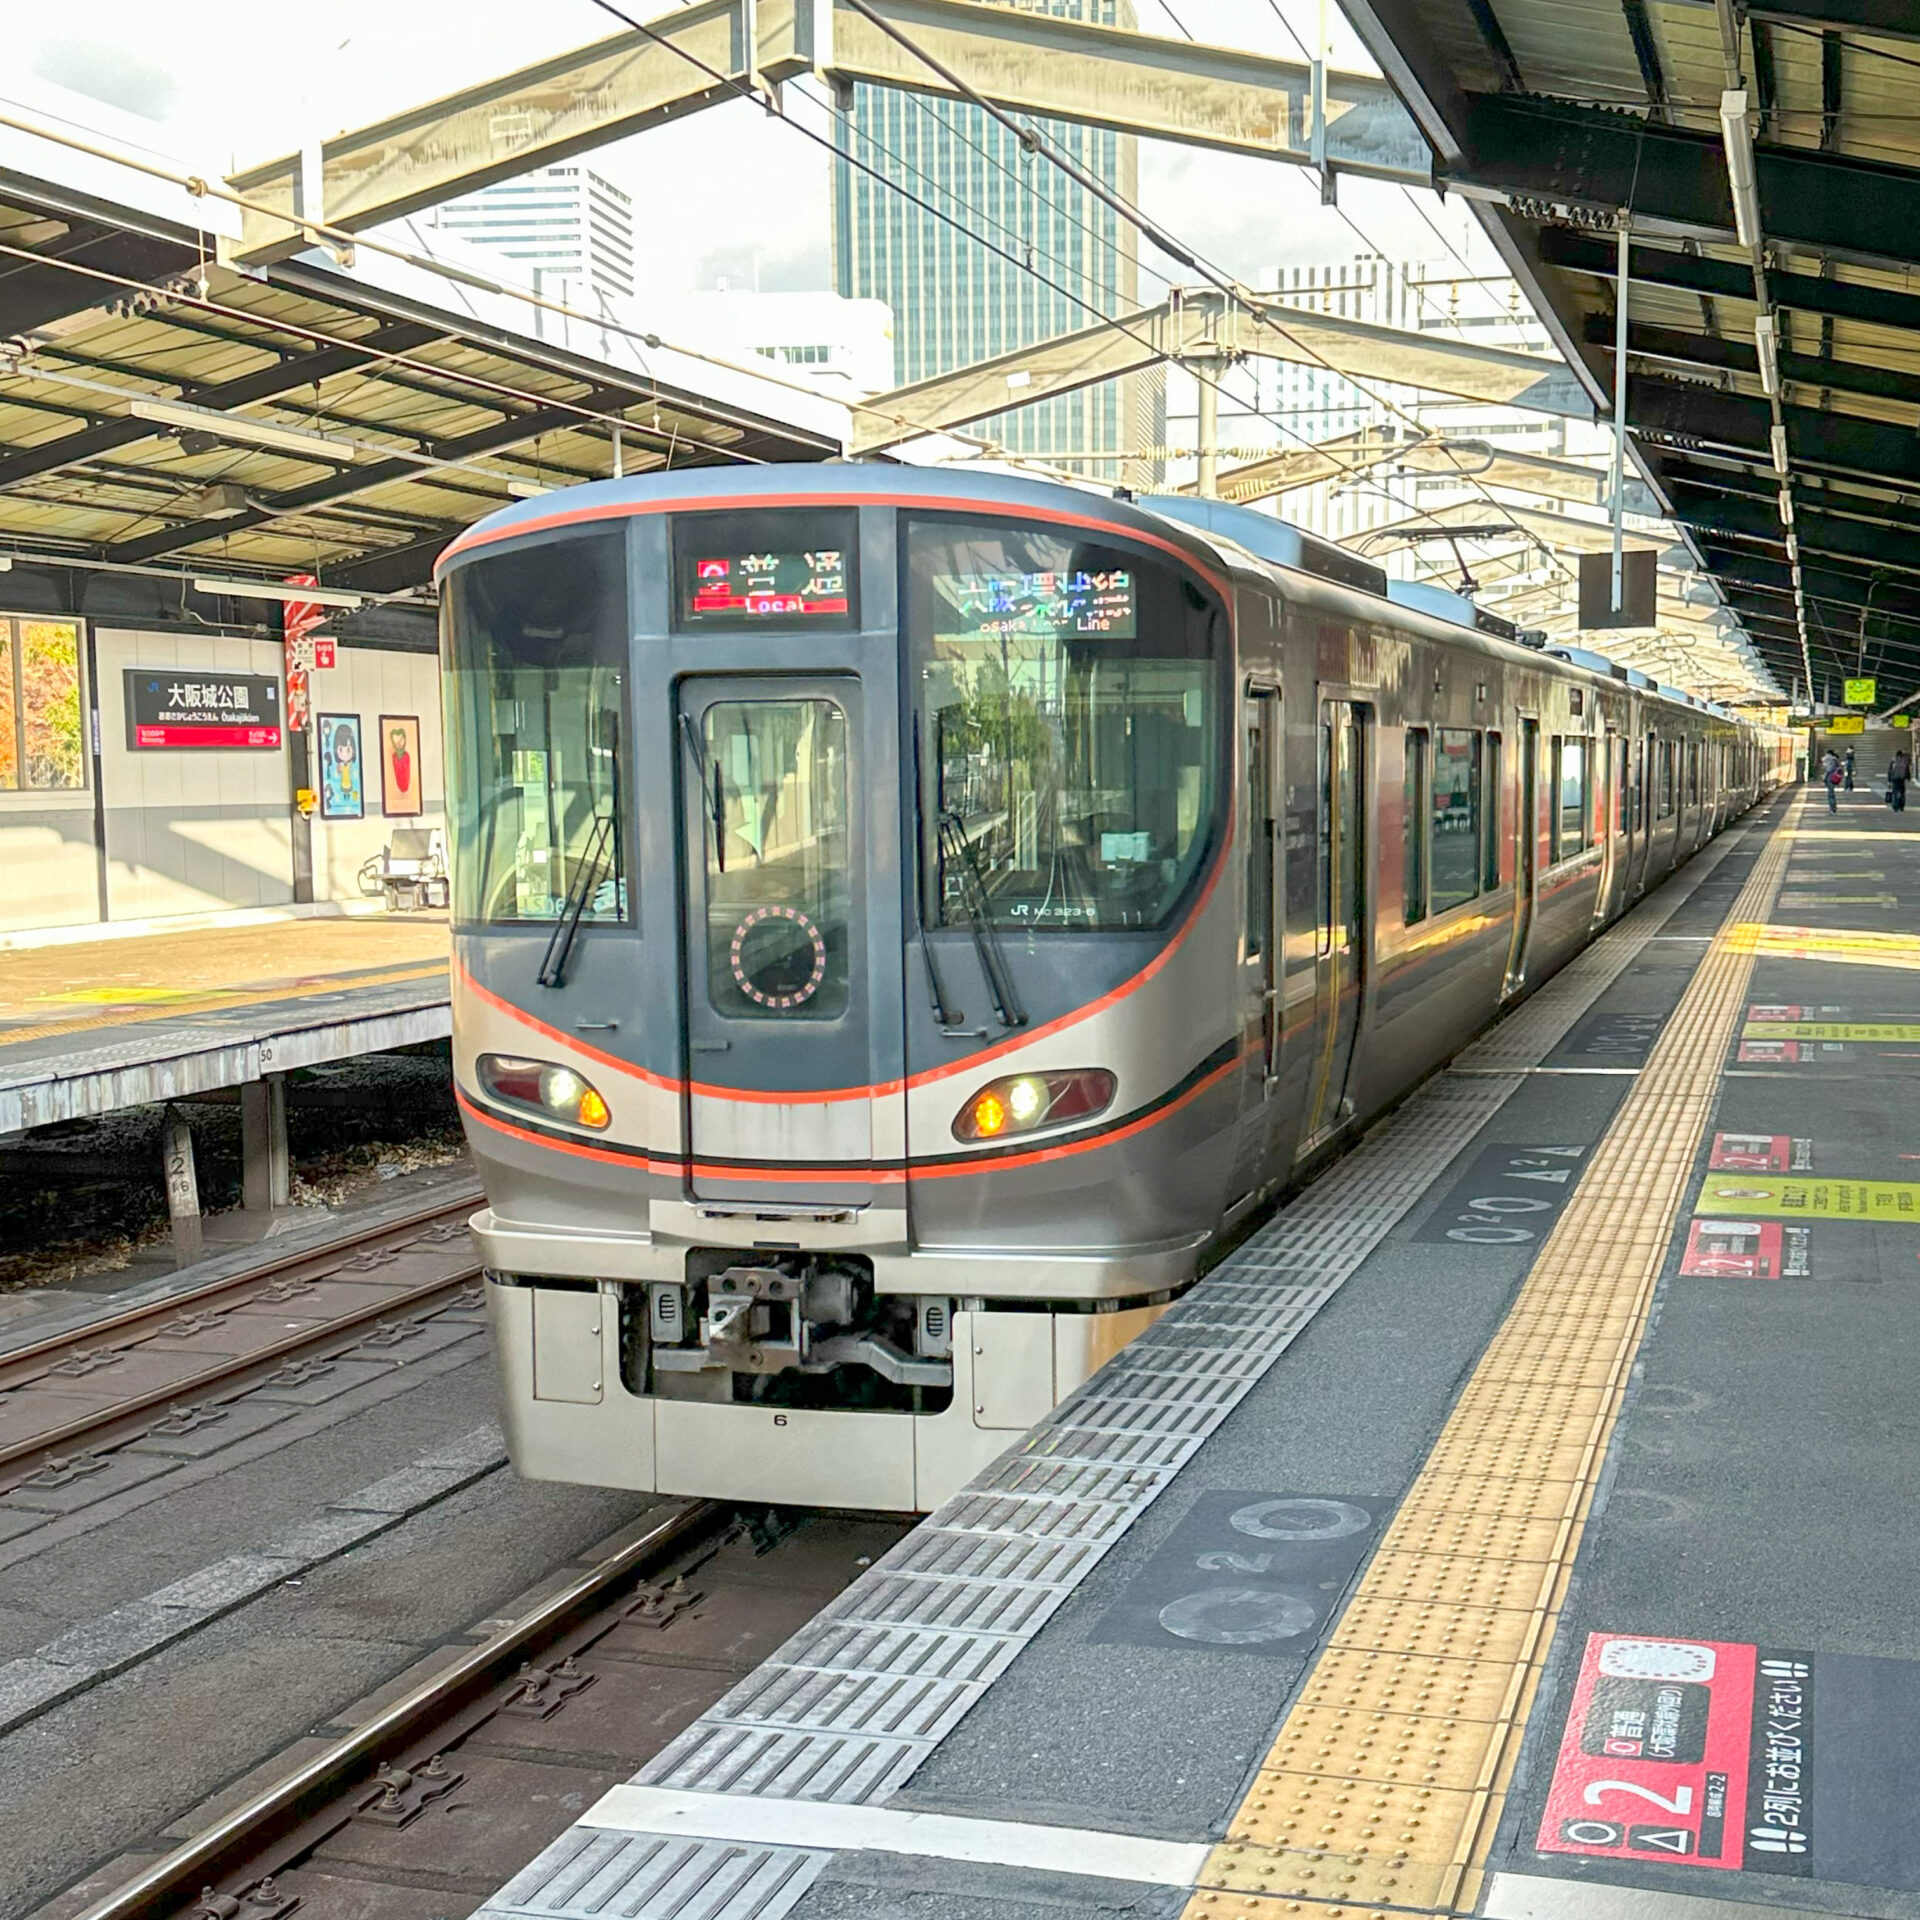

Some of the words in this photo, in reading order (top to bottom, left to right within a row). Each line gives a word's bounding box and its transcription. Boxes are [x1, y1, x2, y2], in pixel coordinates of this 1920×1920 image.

[745, 596, 803, 614] Local
[1076, 617, 1110, 631] Line
[167, 682, 250, 710] 大阪城公園
[1010, 904, 1029, 916] JR
[260, 1048, 273, 1063] 50
[773, 1414, 788, 1427] 6
[1610, 1710, 1646, 1739] 普通
[1763, 1681, 1803, 1827] 2列にお並びください
[1583, 1779, 1693, 1815] 2
